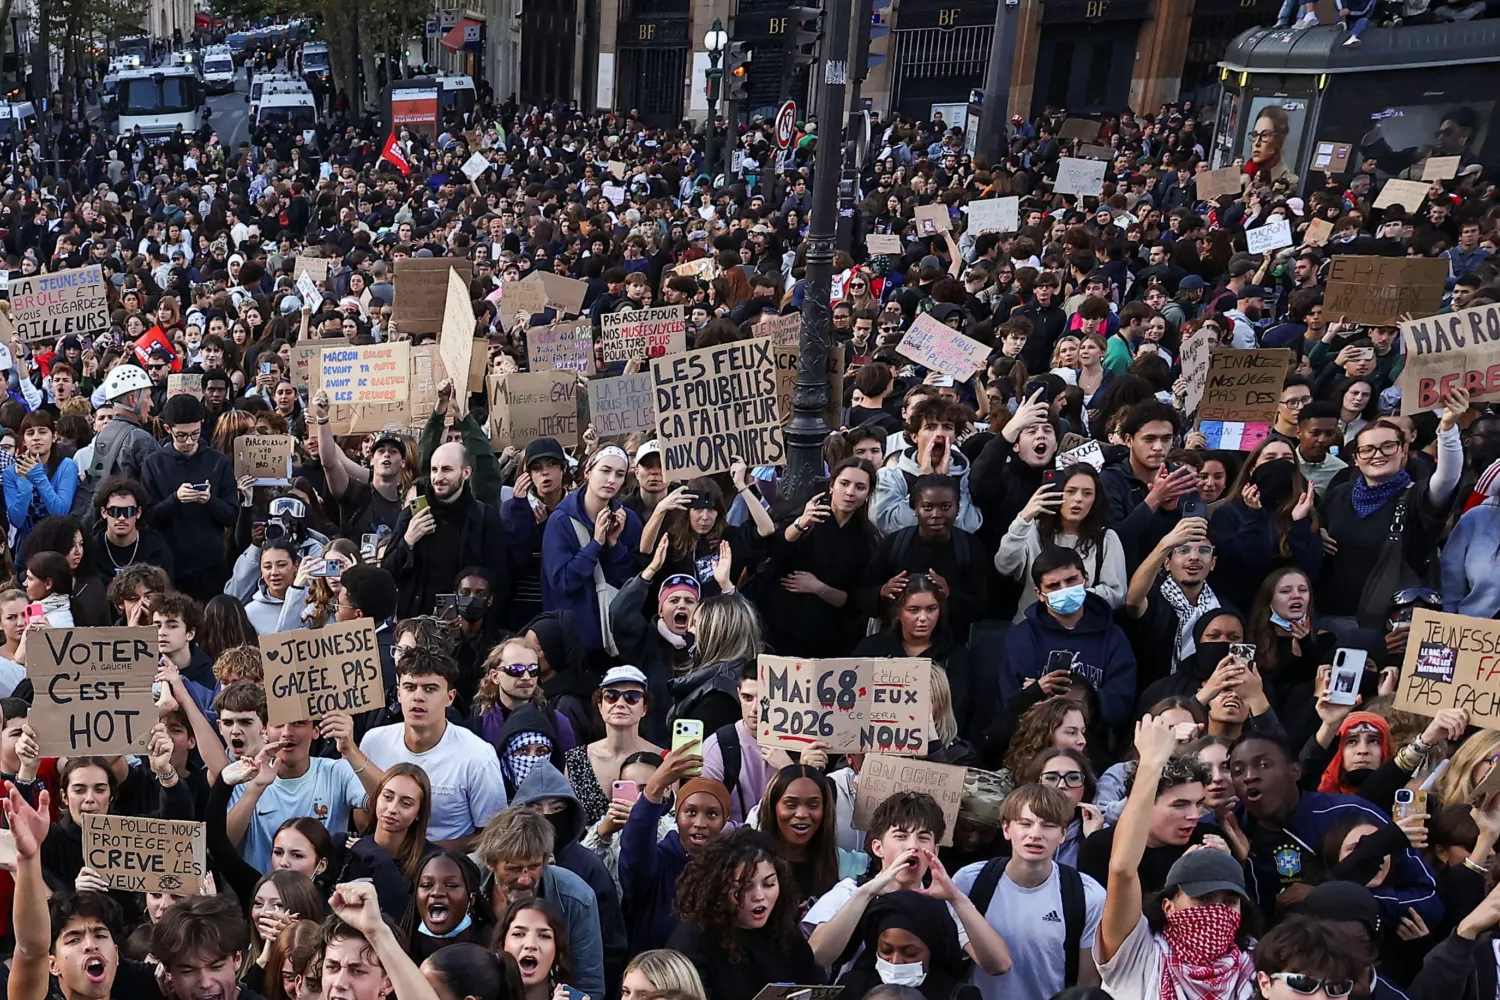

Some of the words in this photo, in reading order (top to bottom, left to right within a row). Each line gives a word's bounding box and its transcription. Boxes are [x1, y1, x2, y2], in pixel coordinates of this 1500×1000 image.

[769, 17, 788, 34] BF
[939, 9, 961, 25] BF
[639, 24, 656, 40] BF
[12, 280, 33, 297] LA
[39, 268, 101, 291] JEUNESSE
[13, 287, 67, 311] BRÛLE
[76, 284, 96, 298] ET
[15, 308, 41, 321] VOUS
[48, 296, 106, 317] REGARDEZ
[603, 313, 621, 327] PAS
[622, 310, 650, 324] ASSEZ
[650, 307, 679, 321] POUR
[16, 310, 107, 340] AILLEURS
[602, 326, 621, 339] NOS
[603, 339, 624, 351] MAIS
[625, 337, 646, 349] TJRS
[648, 334, 671, 348] PLUS
[324, 350, 358, 363] MACRON
[604, 349, 628, 361] POUR
[628, 347, 645, 360] VOS
[323, 364, 352, 376] DEVANT
[359, 363, 370, 374] TA
[653, 352, 706, 388] LES
[713, 342, 774, 377] FEUX
[325, 377, 351, 389] AVANT
[358, 377, 368, 387] DE
[550, 380, 577, 403] GAV
[595, 383, 612, 400] LA
[658, 384, 684, 412] DE
[682, 368, 776, 408] POUBELLES
[1210, 375, 1234, 388] NOS
[334, 390, 353, 402] LES
[595, 395, 620, 412] NOUS
[1208, 389, 1237, 406] PAS
[1245, 391, 1275, 406] DES
[658, 406, 686, 441] ÇA
[732, 394, 778, 430] PEUR
[245, 437, 288, 447] PARCOURSUP
[664, 442, 695, 473] AUX
[698, 425, 783, 472] ORDURES
[44, 630, 155, 667] VOTER
[280, 627, 374, 665] JEUNESSE
[1421, 648, 1428, 656] LE
[90, 662, 97, 672] À
[100, 662, 133, 671] GAUCHE
[272, 665, 337, 698] GAZÉE,
[341, 657, 378, 686] PAS
[47, 671, 125, 705] C'EST
[816, 669, 858, 708] 68
[873, 687, 918, 706] EUX
[1404, 673, 1443, 706] PAS
[772, 706, 835, 738] 2026
[847, 709, 863, 721] ce
[869, 711, 897, 721] SERA
[859, 725, 924, 750] NOUS
[868, 759, 896, 780] ON
[91, 816, 111, 831] LA
[120, 819, 168, 836] POLICE
[171, 822, 201, 839] NOUS
[174, 840, 194, 858] ÇA
[89, 848, 166, 873] CREVE
[172, 859, 202, 877] LES
[106, 872, 146, 890] YEUX
